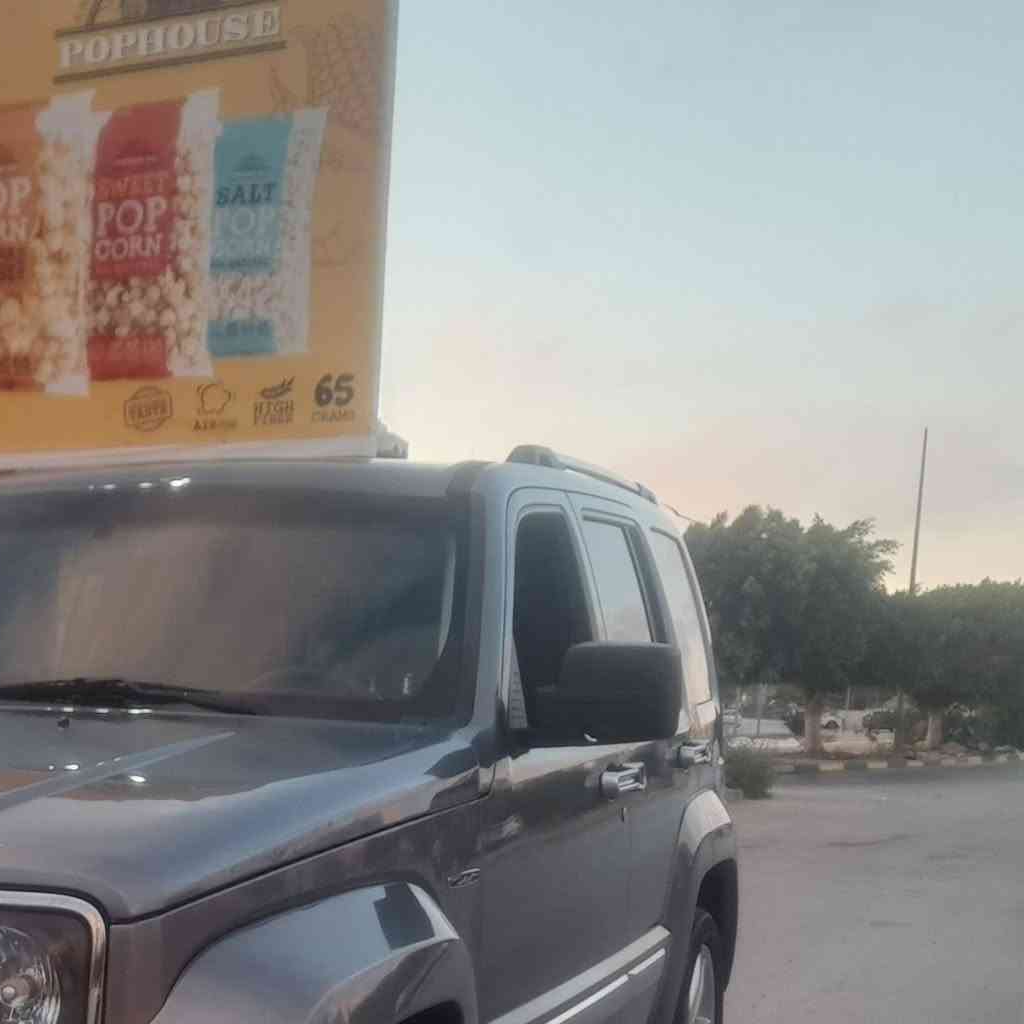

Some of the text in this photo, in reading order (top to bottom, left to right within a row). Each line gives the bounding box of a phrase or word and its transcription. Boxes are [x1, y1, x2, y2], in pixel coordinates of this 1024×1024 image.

[60, 5, 282, 68] POPHOUSE
[216, 182, 277, 206] SALT
[96, 196, 167, 236] POP
[213, 206, 275, 236] POP
[94, 233, 163, 260] CORN
[314, 373, 356, 407] 65
